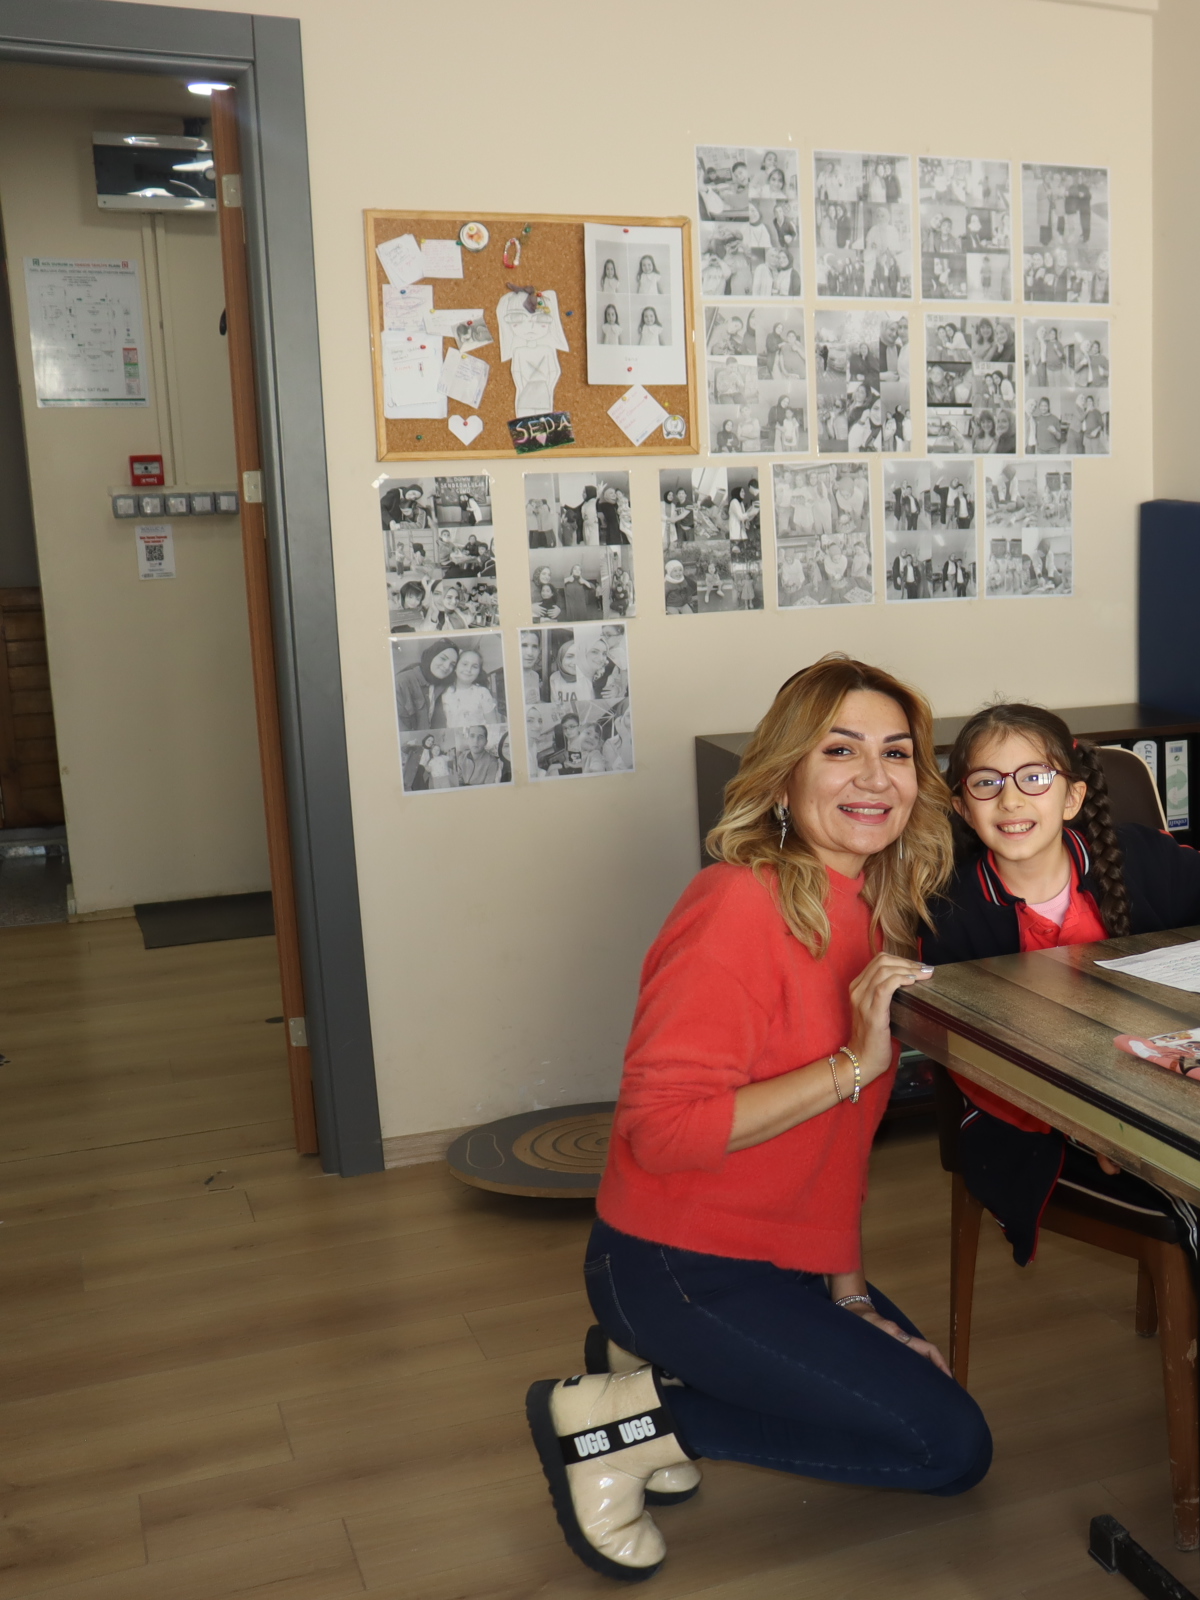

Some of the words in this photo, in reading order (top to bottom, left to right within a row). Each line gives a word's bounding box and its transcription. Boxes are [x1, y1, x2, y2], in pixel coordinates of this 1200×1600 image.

[515, 415, 571, 443] SEDA
[574, 1429, 611, 1458] UGG
[618, 1415, 657, 1445] UGG
